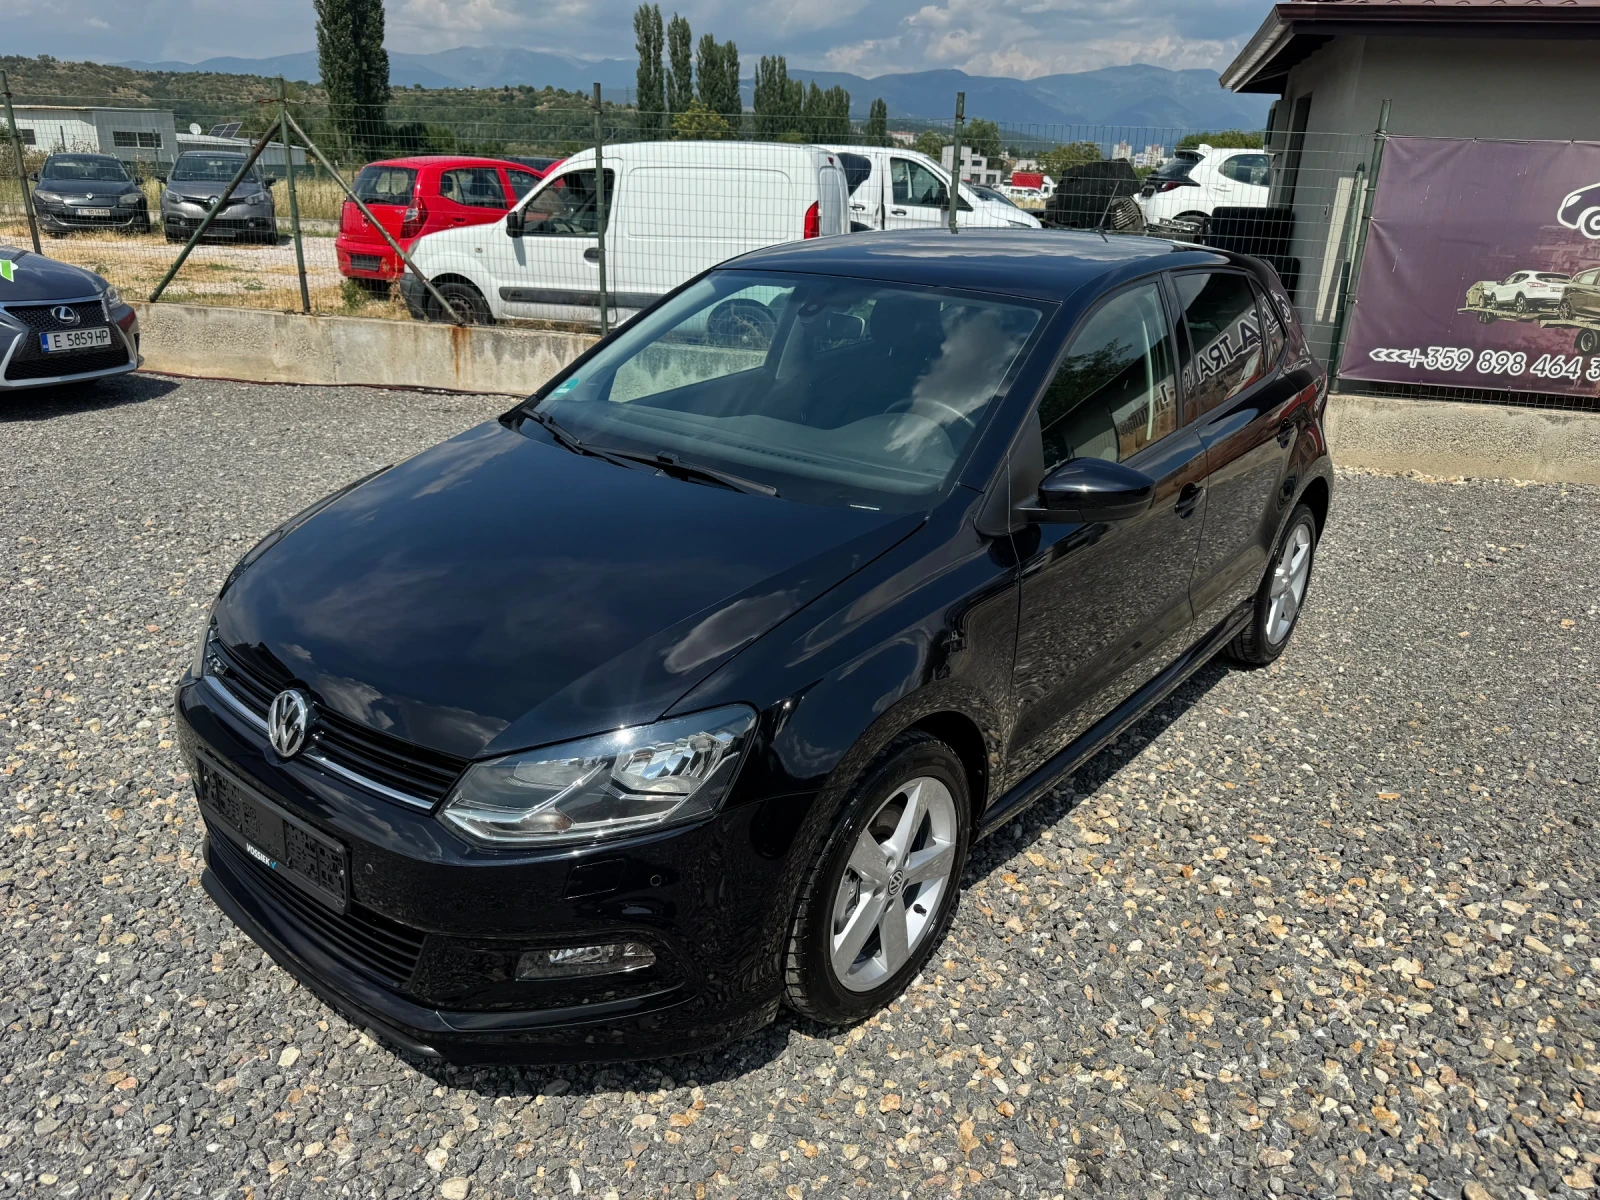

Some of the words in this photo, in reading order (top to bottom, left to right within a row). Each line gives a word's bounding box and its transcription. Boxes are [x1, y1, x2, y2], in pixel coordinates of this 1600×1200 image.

[53, 335, 62, 348] E
[67, 332, 94, 347] 5859
[95, 330, 109, 344] HP
[1406, 346, 1474, 371] +359
[1476, 349, 1527, 376] 898
[1530, 354, 1583, 380] 464
[246, 843, 270, 867] VOSSIEK
